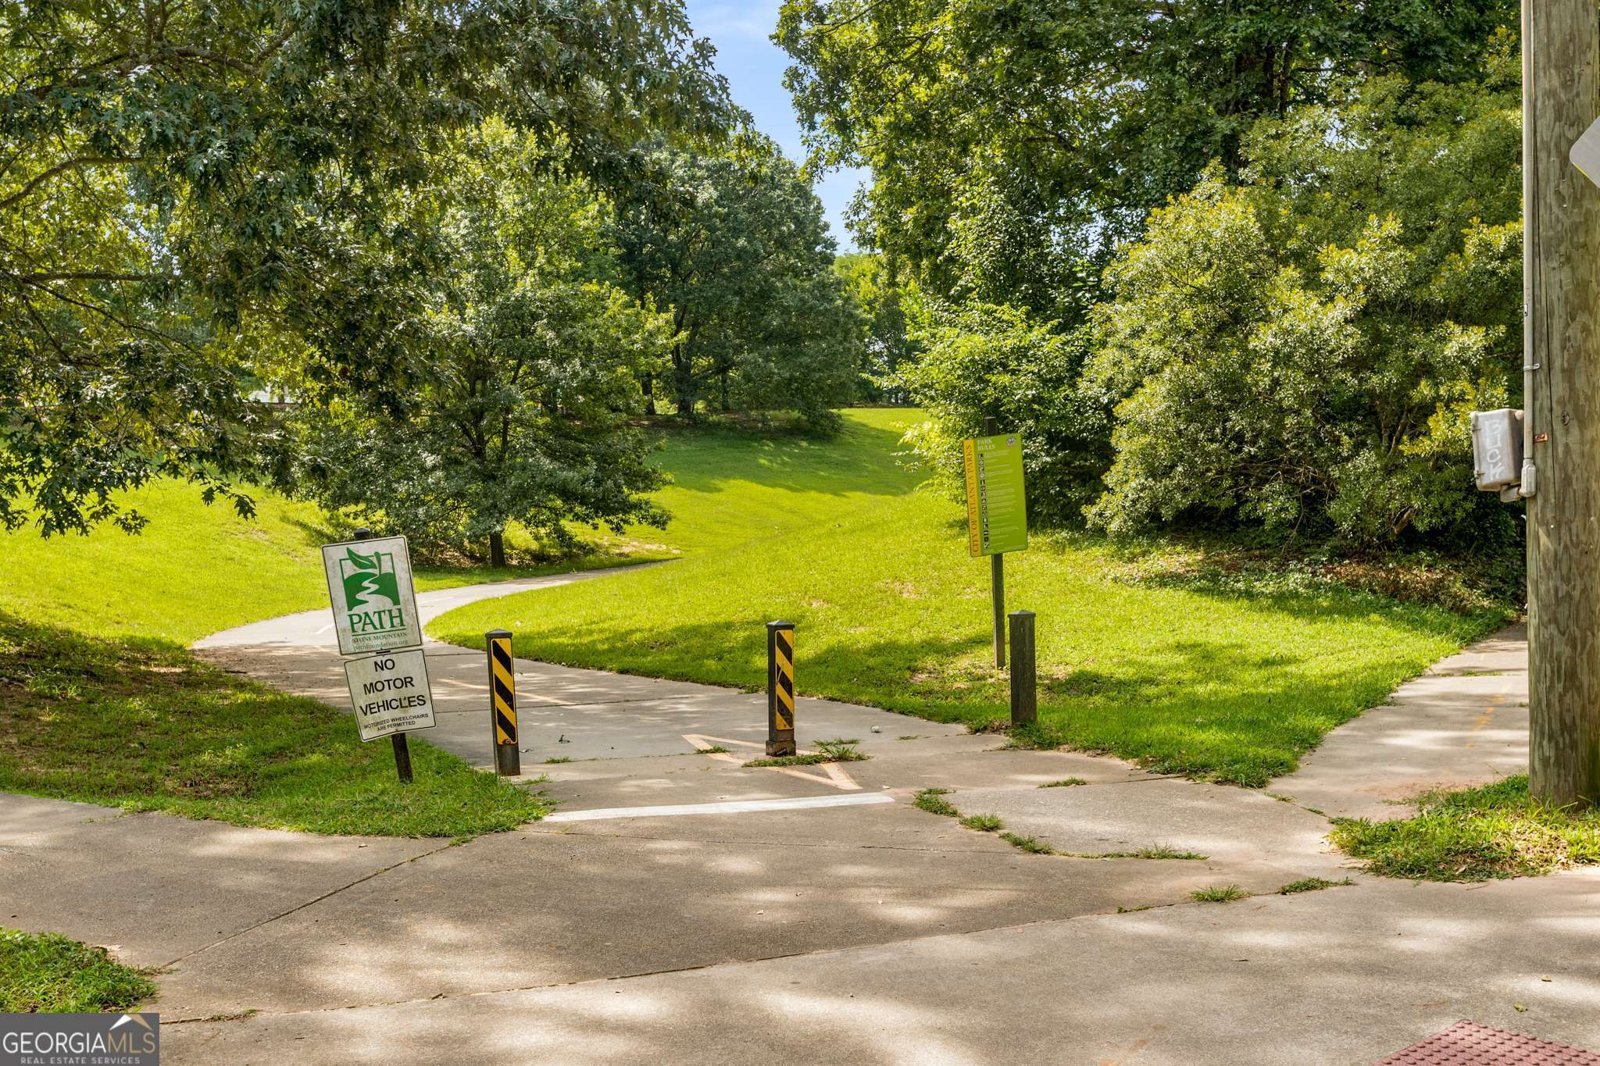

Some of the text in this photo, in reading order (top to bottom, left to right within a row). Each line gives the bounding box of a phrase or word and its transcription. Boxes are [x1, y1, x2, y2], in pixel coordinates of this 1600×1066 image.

[966, 444, 979, 553] CITY OF ATLANTA PARKS
[347, 607, 406, 634] PATH
[373, 631, 408, 641] MOUNTAIN
[374, 658, 395, 672] NO
[363, 676, 415, 695] MOTOR
[359, 694, 427, 716] VEHICLES
[364, 713, 429, 729] MOTORIZED WHEELCHAIRS
[387, 720, 416, 729] PERMITTED
